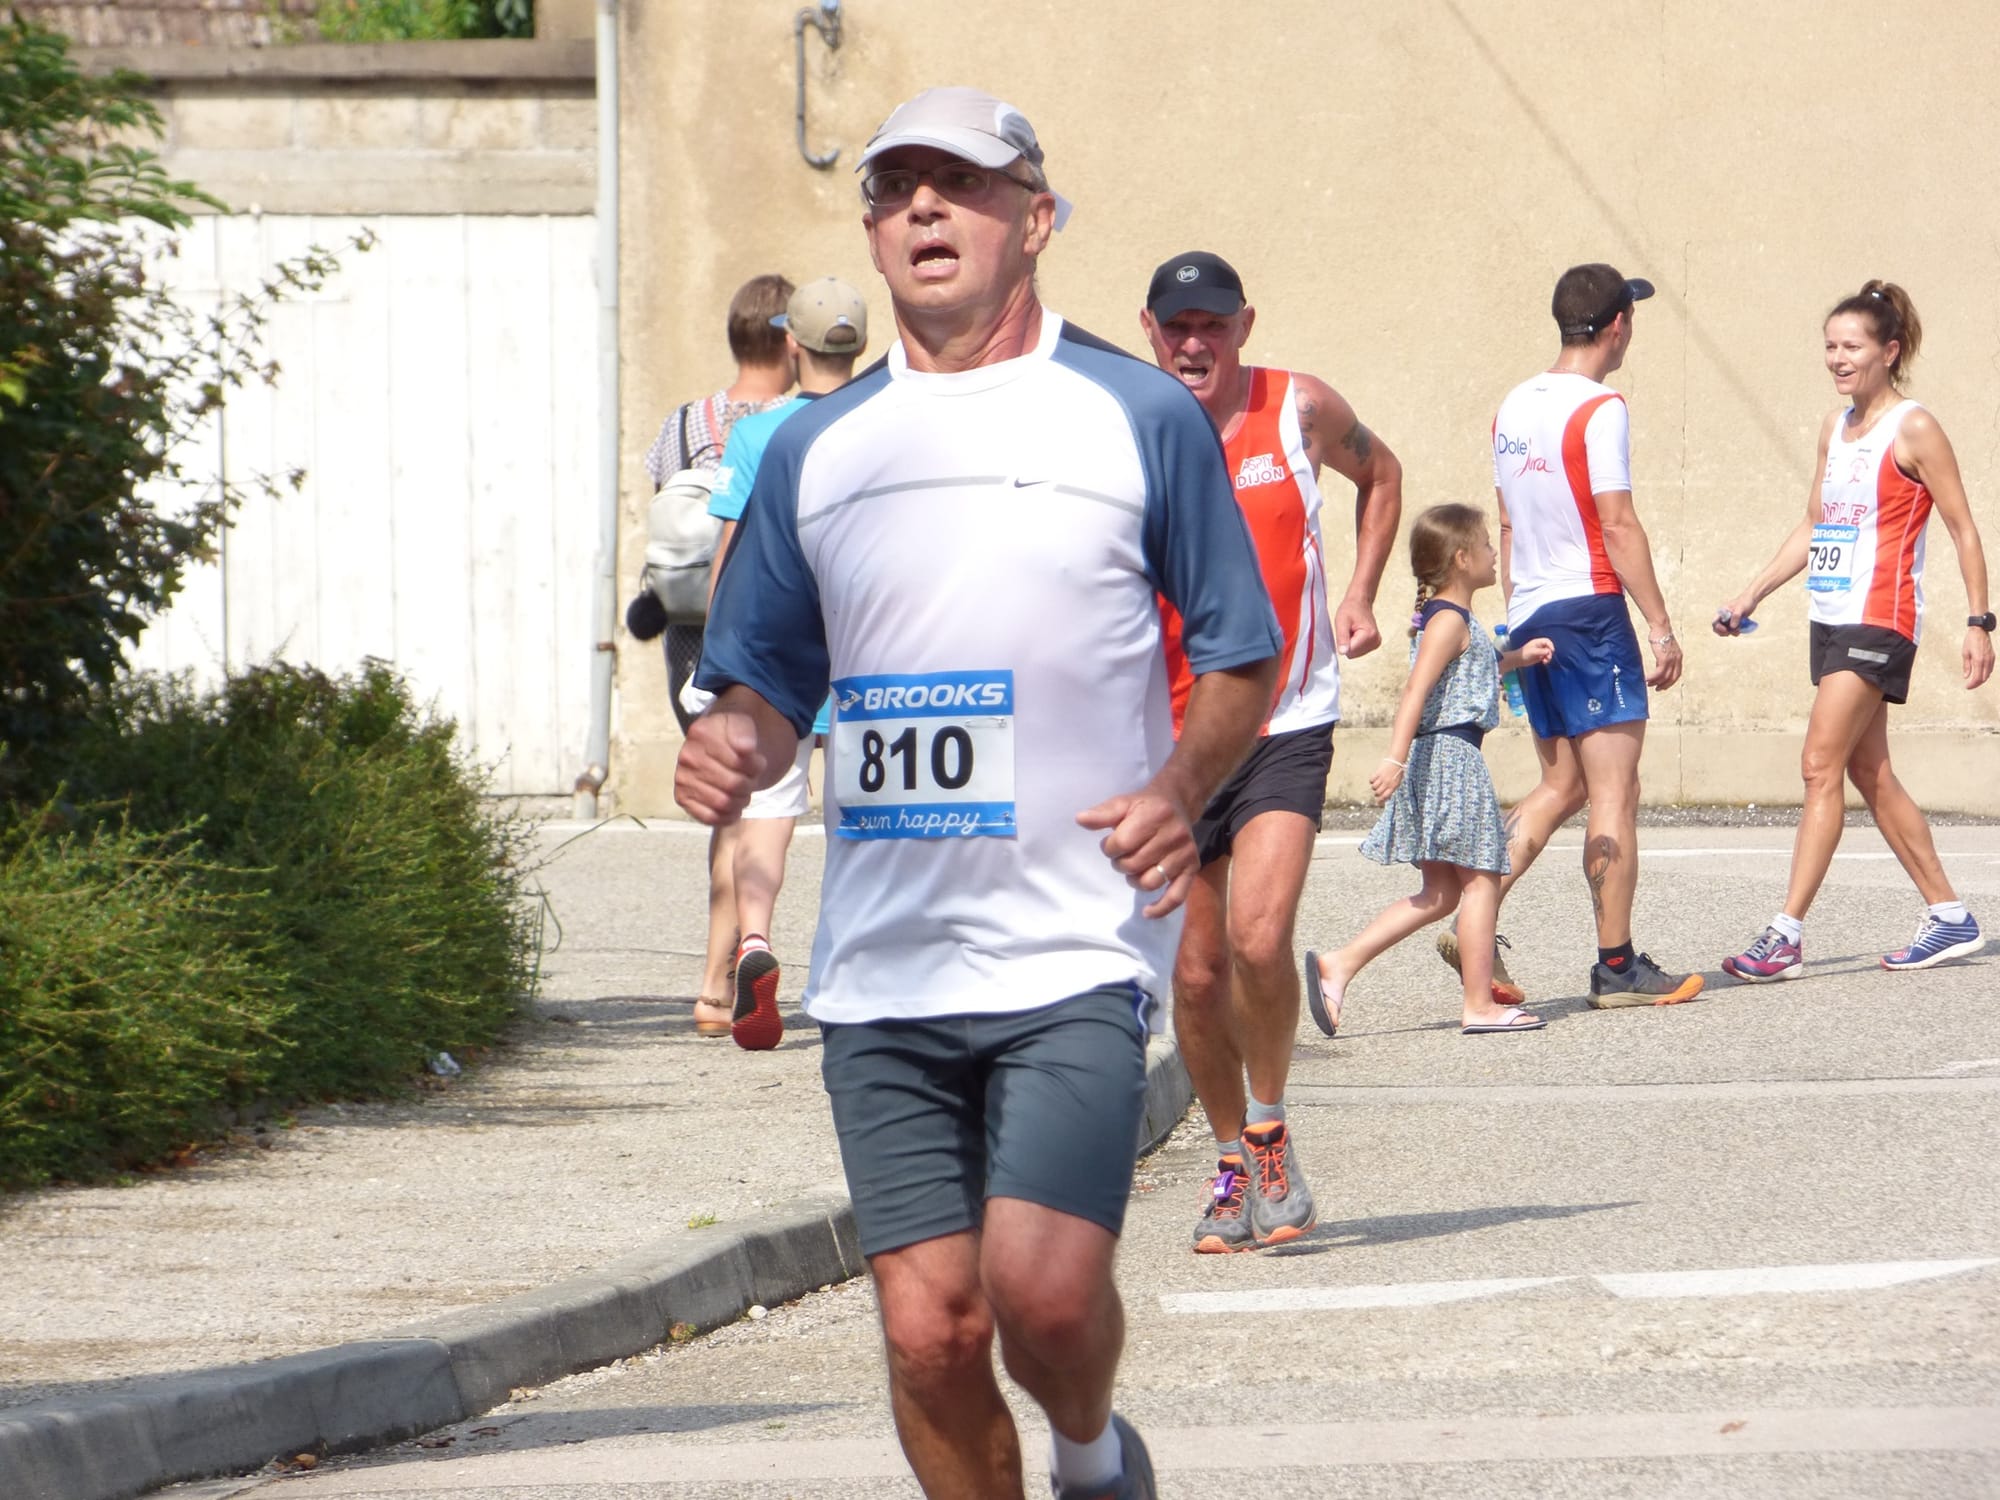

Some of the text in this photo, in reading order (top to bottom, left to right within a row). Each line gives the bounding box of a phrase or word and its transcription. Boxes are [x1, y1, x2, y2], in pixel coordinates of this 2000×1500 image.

[1498, 432, 1527, 455] Dole
[1237, 467, 1283, 487] DIJON
[1809, 546, 1841, 571] 799
[865, 683, 1006, 710] BROOKS
[859, 726, 973, 792] 810
[896, 808, 980, 835] happy
